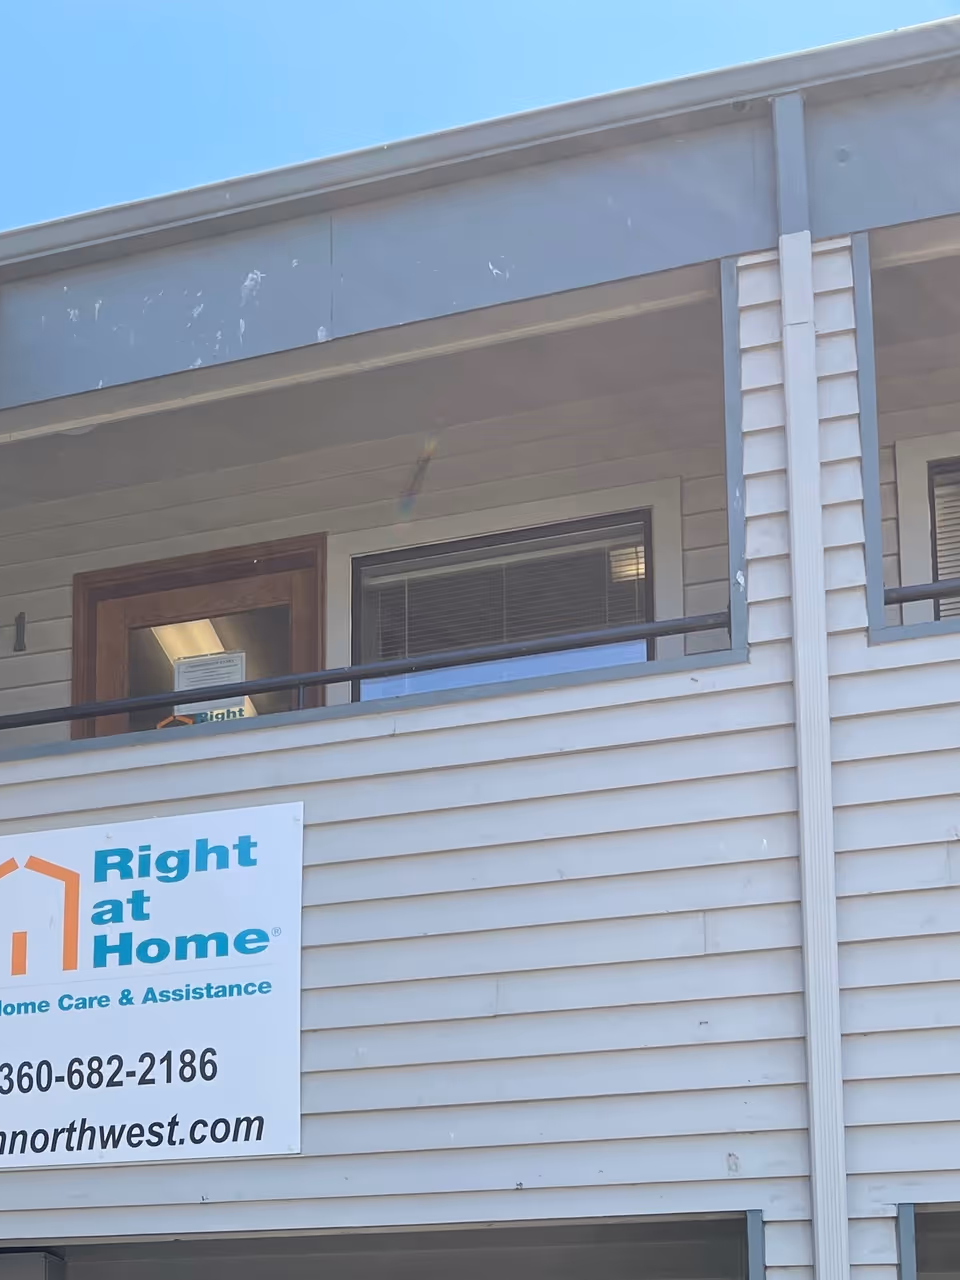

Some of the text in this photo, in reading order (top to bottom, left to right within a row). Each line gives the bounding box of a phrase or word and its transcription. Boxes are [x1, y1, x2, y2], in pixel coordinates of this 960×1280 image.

[200, 708, 244, 723] Right
[93, 835, 258, 883] Right
[90, 889, 151, 925] at
[58, 993, 110, 1011] Care
[118, 988, 134, 1006] &
[141, 979, 272, 1005] Assistance
